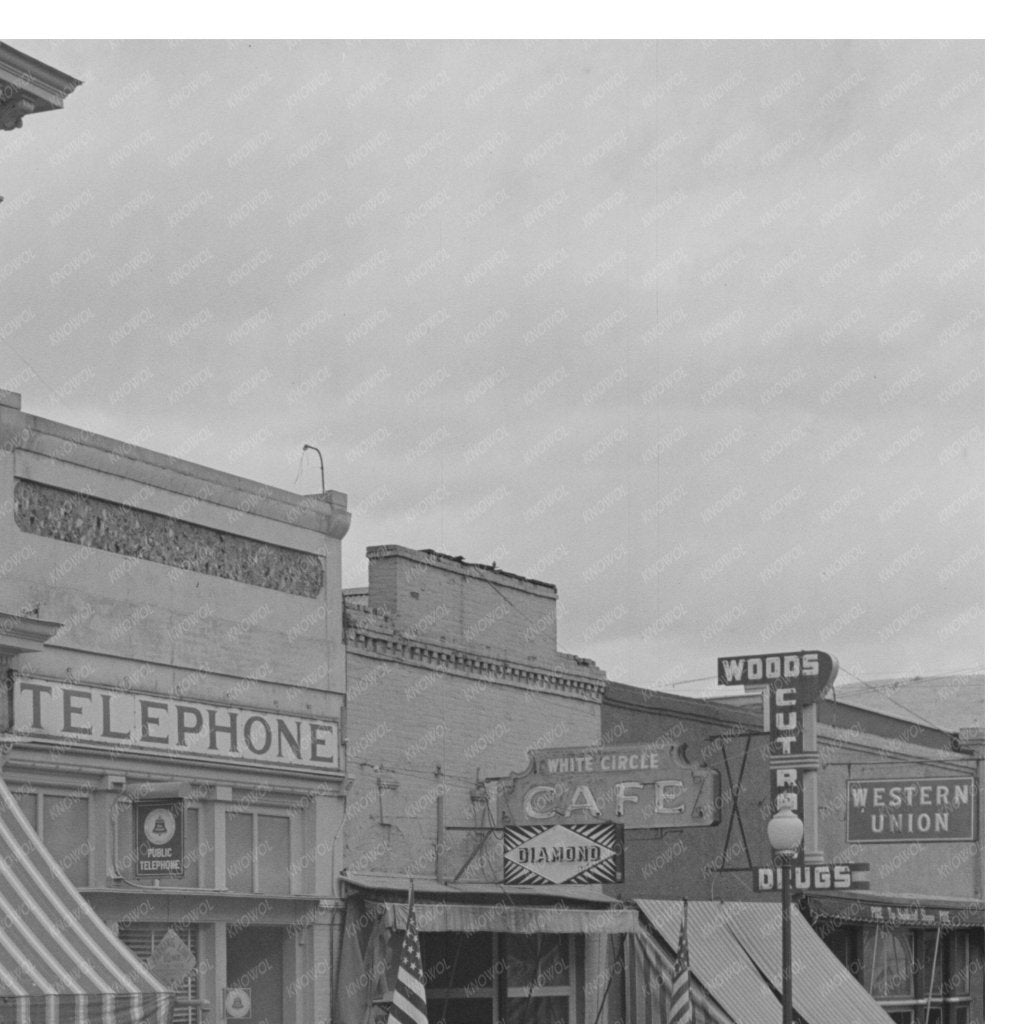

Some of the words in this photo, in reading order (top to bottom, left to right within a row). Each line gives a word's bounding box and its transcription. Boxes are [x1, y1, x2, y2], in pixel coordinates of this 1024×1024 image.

[723, 652, 820, 682] WOODS
[20, 683, 334, 764] TELEPHONE
[776, 688, 798, 754] CUT
[547, 757, 594, 773] WHITE
[601, 753, 660, 771] CIRCLE
[524, 780, 685, 819] CAFE
[851, 785, 969, 807] WESTERN
[871, 813, 949, 833] UNION
[147, 848, 172, 858] PUBLIC
[518, 846, 601, 863] DIAMOND
[139, 860, 180, 870] TELEPHONE
